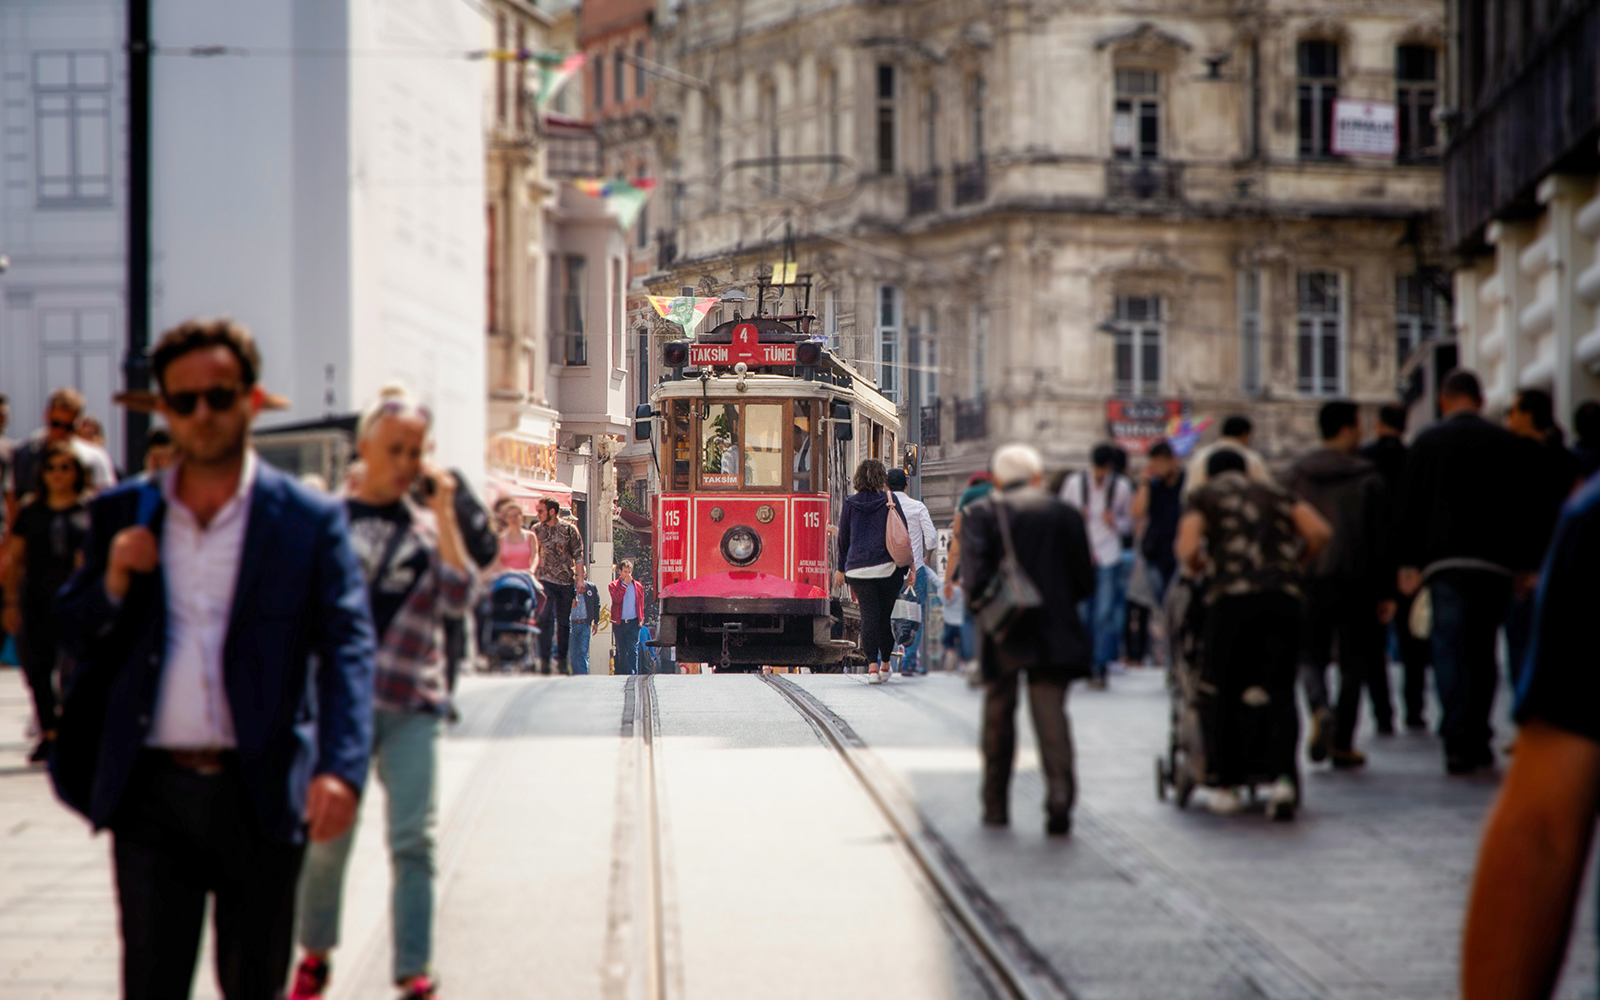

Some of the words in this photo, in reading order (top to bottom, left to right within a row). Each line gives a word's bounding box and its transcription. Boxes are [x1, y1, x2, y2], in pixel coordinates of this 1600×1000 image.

[739, 327, 748, 343] 4
[692, 347, 728, 361] TAKSİM
[764, 346, 796, 361] TÜNEL
[665, 510, 679, 526] 115
[804, 512, 819, 527] 115
